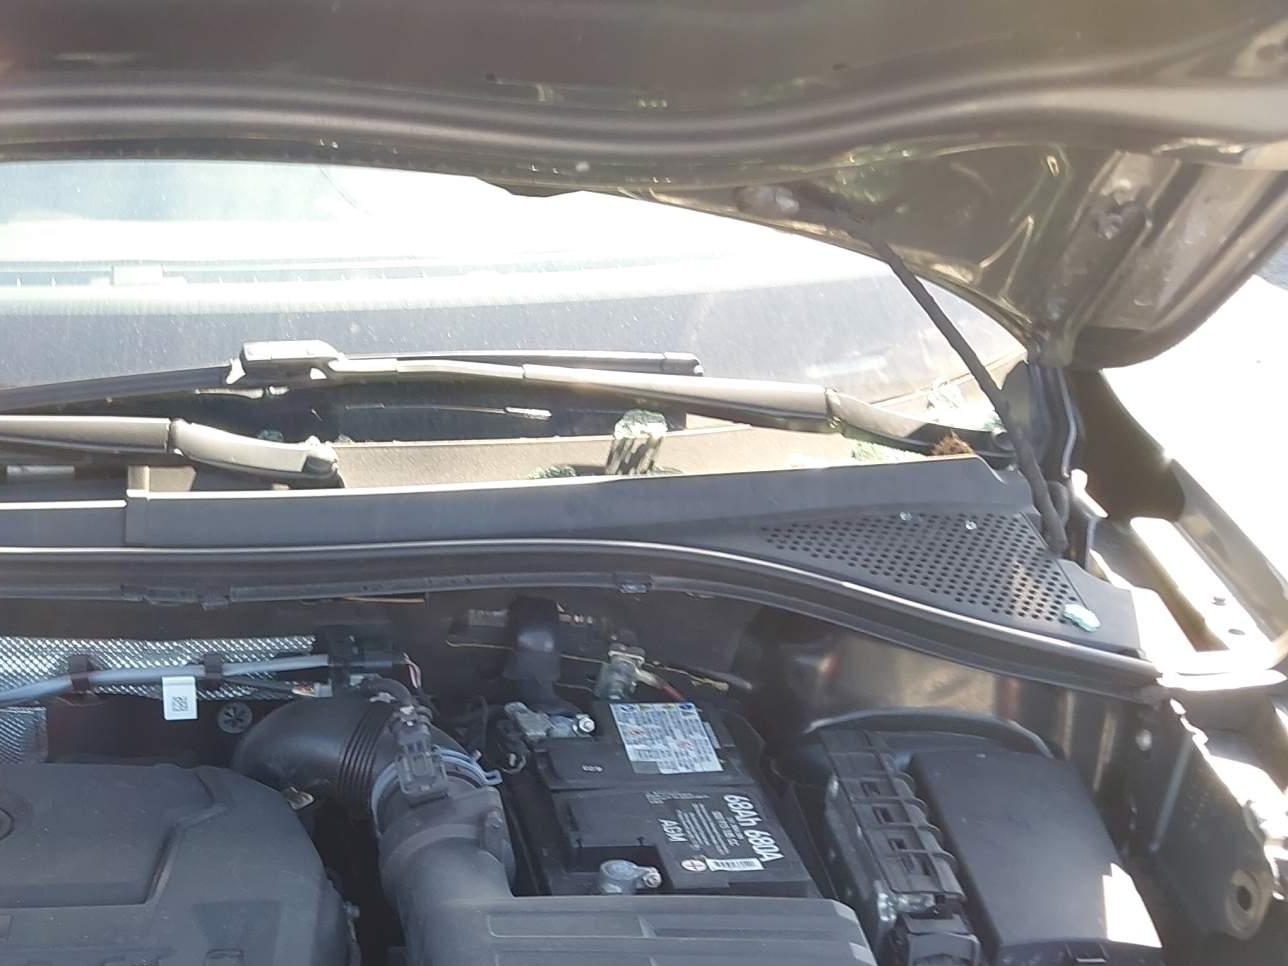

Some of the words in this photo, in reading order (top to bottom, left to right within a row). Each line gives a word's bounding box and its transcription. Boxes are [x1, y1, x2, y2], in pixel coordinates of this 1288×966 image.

[657, 818, 689, 842] AGM
[723, 794, 762, 827] 68Ah
[743, 829, 784, 863] 680A
